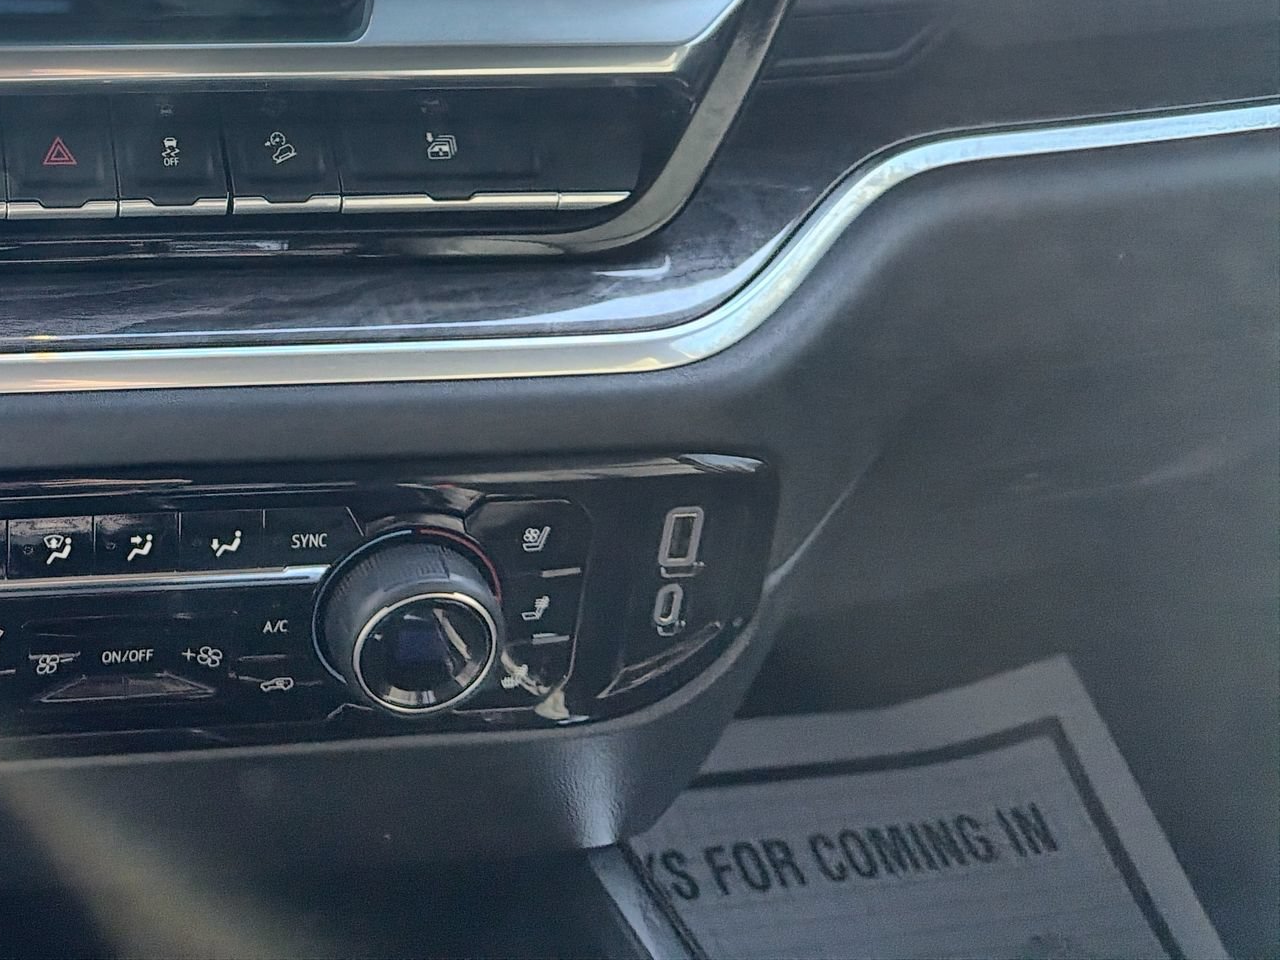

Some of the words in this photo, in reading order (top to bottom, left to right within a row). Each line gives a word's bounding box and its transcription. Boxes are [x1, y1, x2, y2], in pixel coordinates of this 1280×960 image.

[163, 157, 180, 167] OFF
[291, 534, 328, 549] SYNC
[263, 620, 288, 633] A/C
[101, 649, 154, 664] ON/OFF
[707, 836, 806, 897] FOR
[810, 813, 998, 884] COMING
[997, 802, 1059, 855] IN
